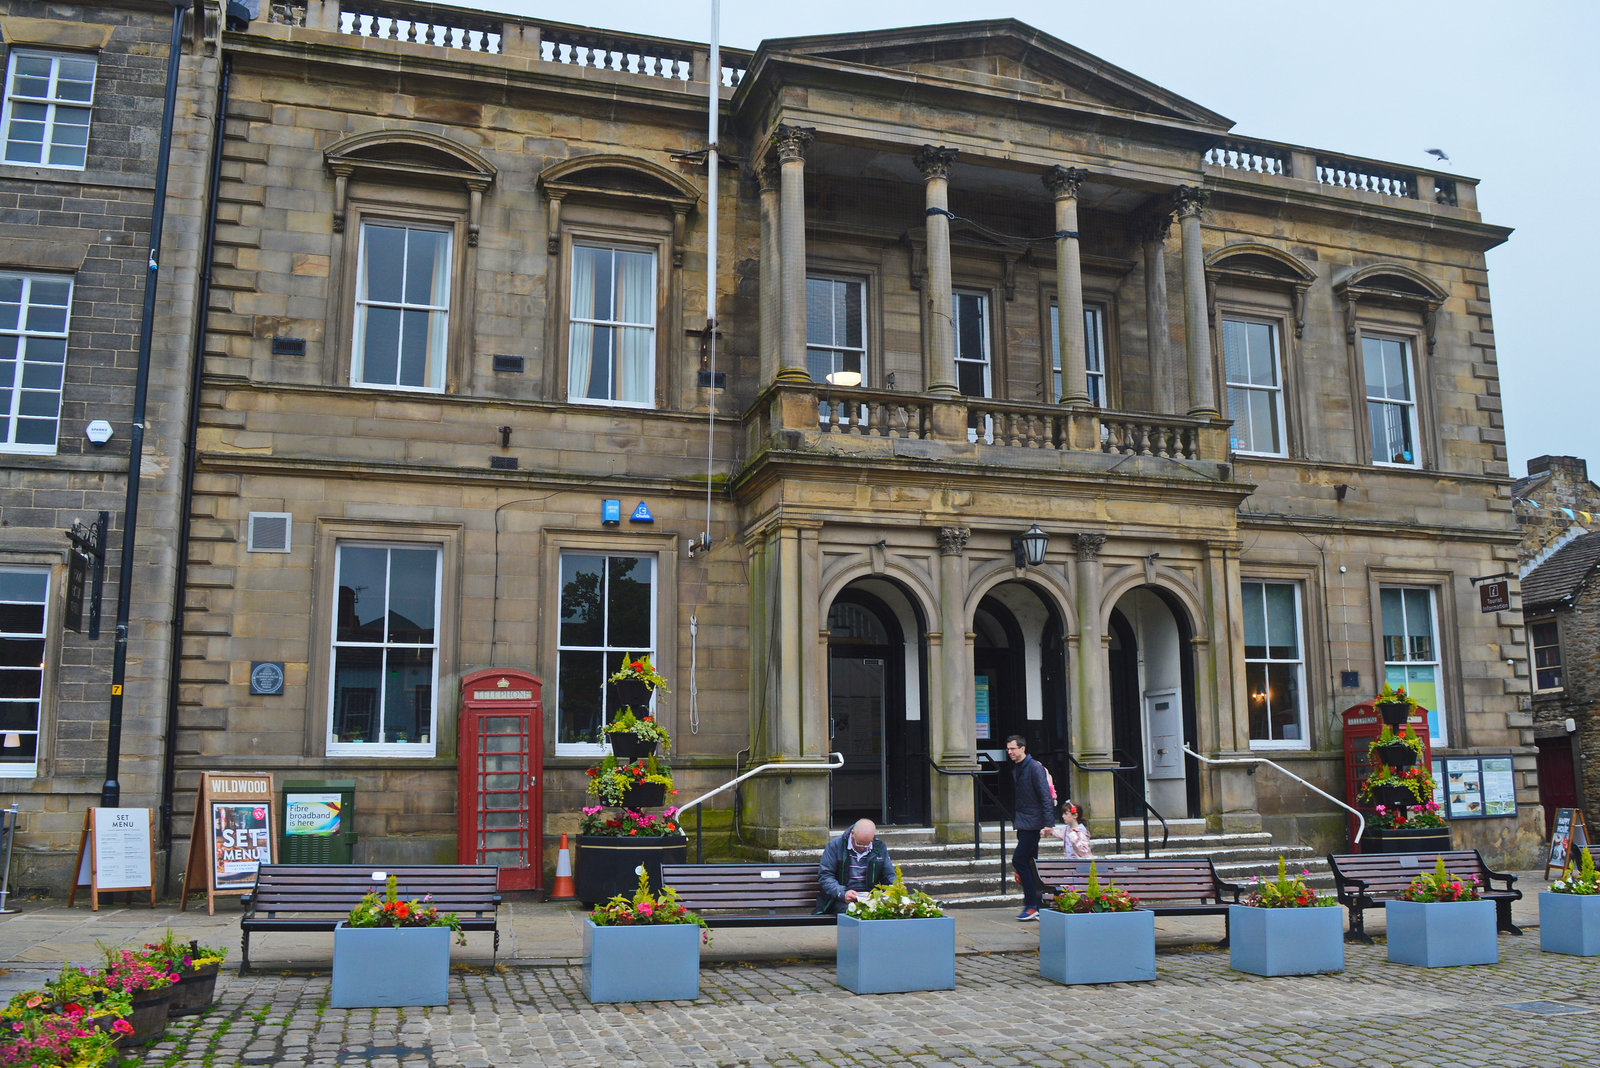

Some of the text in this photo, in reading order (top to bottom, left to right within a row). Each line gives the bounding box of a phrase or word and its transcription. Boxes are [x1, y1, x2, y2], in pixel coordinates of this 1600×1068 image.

[114, 686, 120, 694] 7
[476, 690, 529, 699] TELEPHONE
[211, 779, 267, 793] WILDWOOD
[290, 804, 309, 812] Fibre
[297, 819, 315, 827] here
[222, 828, 262, 848] SET
[223, 849, 260, 861] MENU
